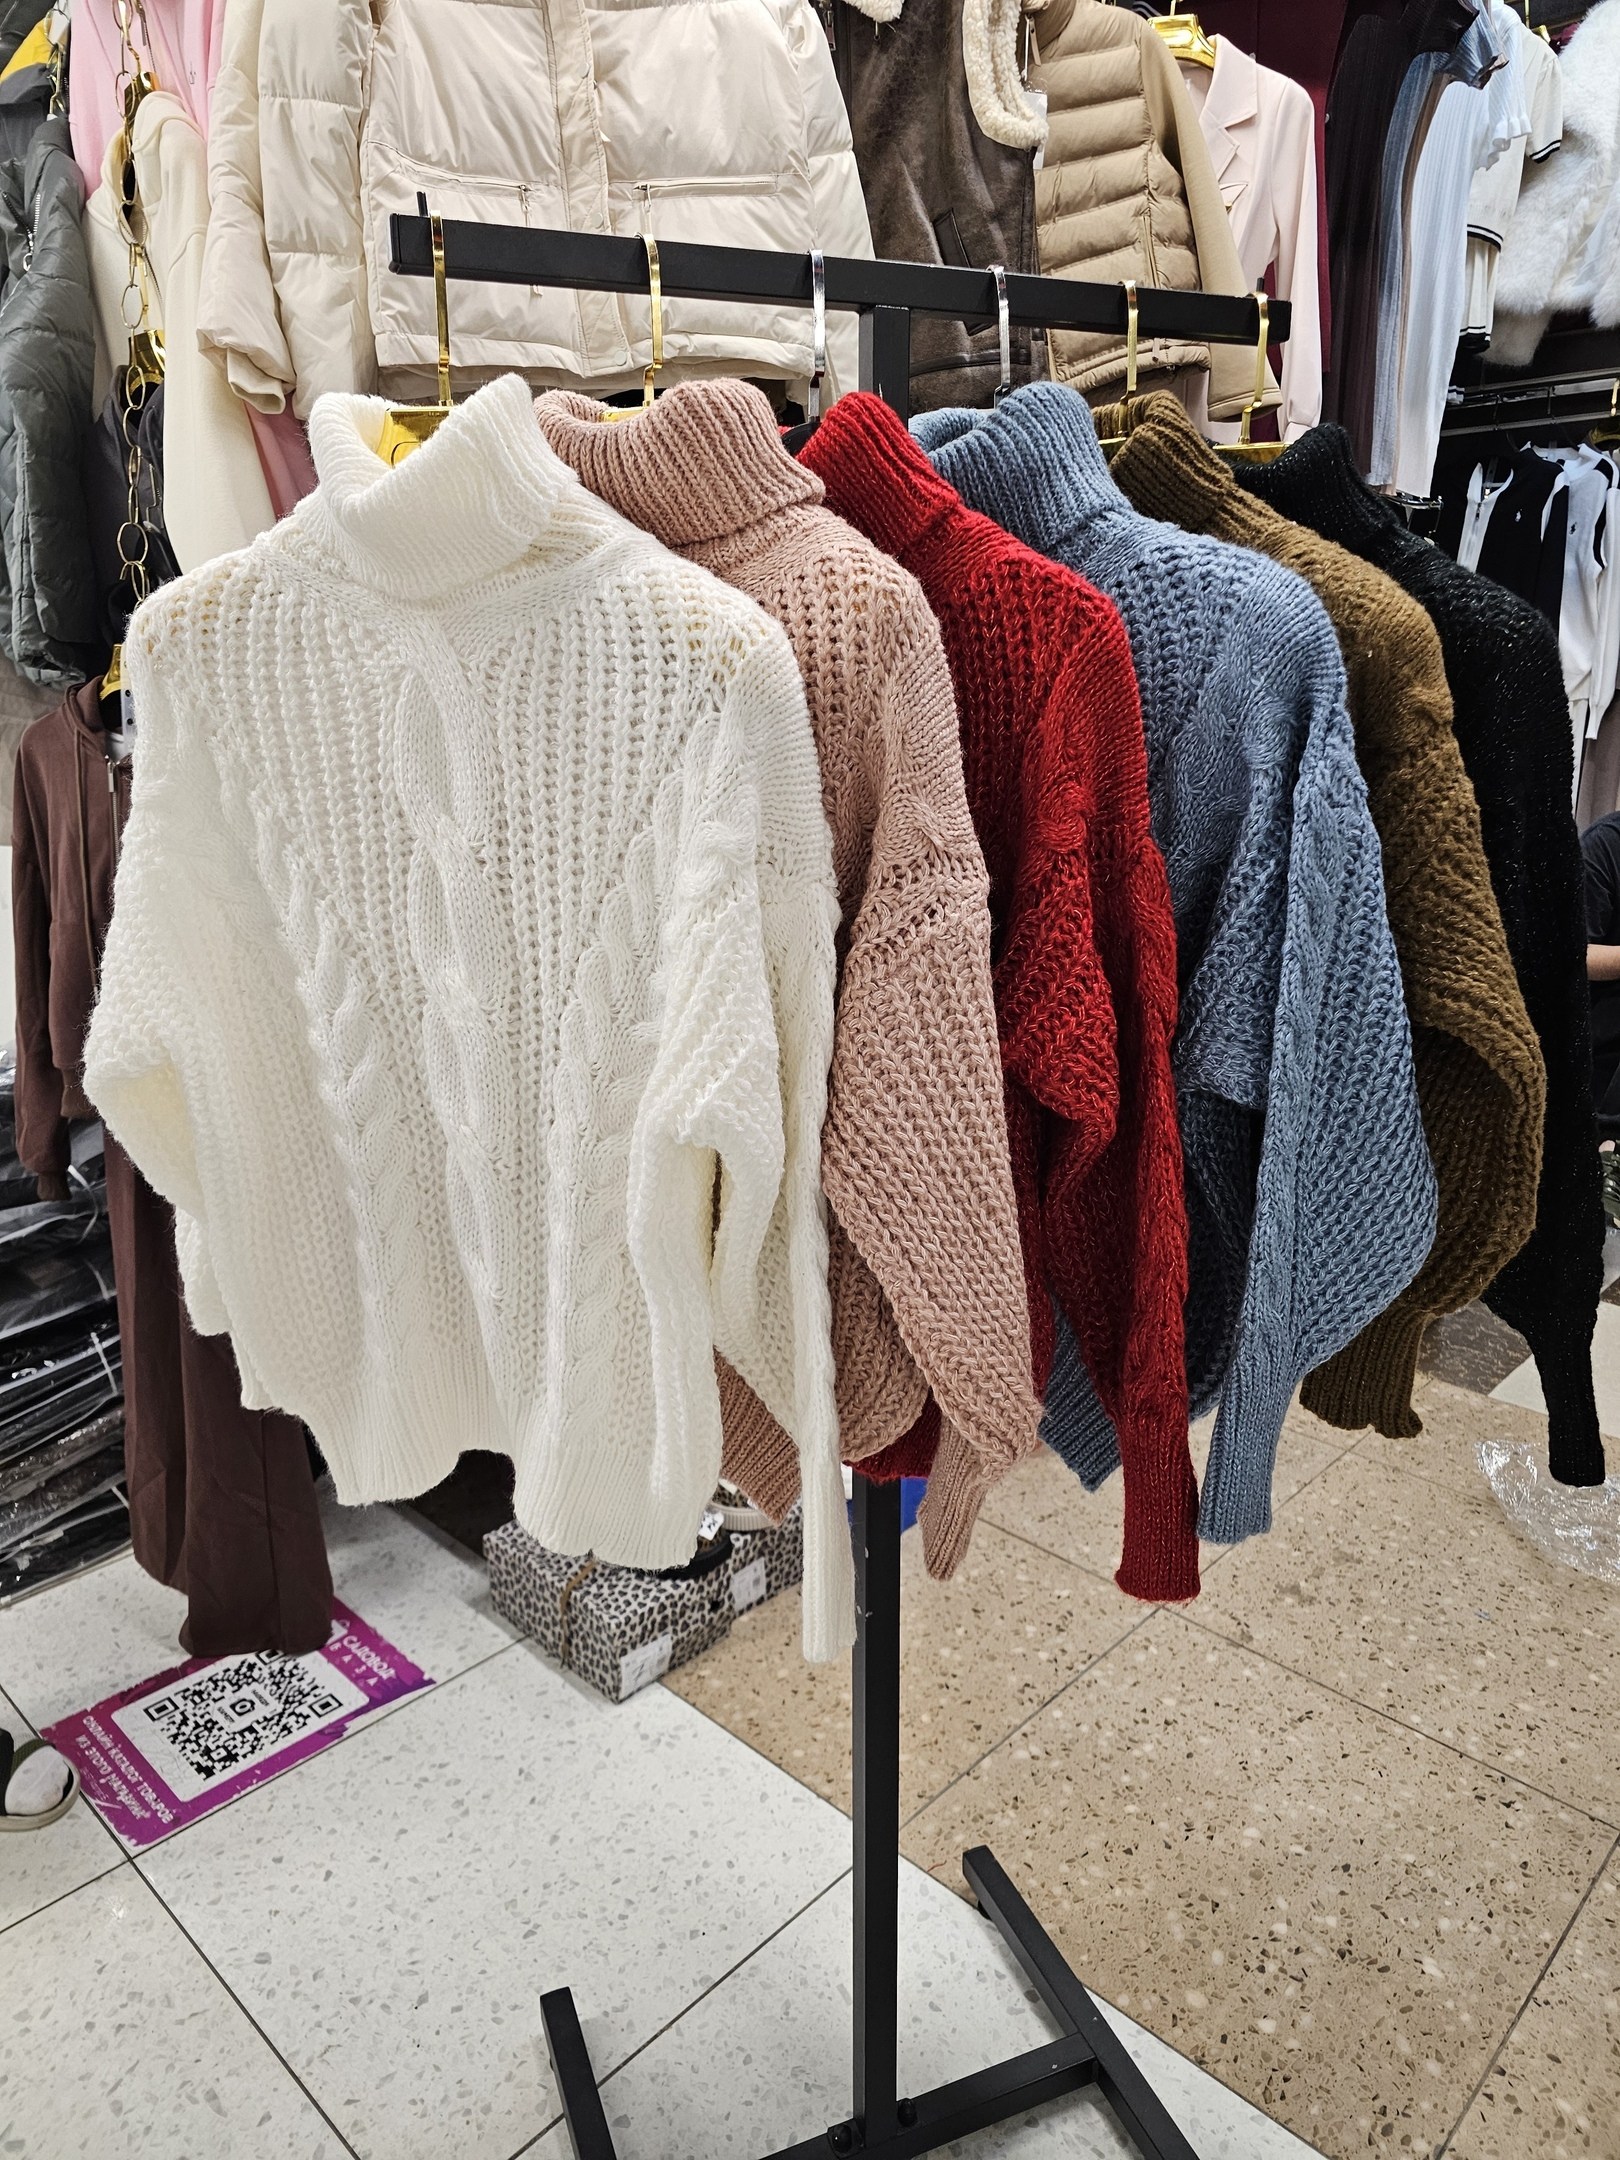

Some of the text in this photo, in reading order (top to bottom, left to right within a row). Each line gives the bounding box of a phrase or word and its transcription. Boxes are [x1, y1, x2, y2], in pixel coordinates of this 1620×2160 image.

[83, 1716, 115, 1750] ОНЛАЙН
[108, 1746, 143, 1783] КАТАЛОГ
[137, 1782, 174, 1824] ТОВАРОВ
[85, 1747, 112, 1775] ЭТОГО
